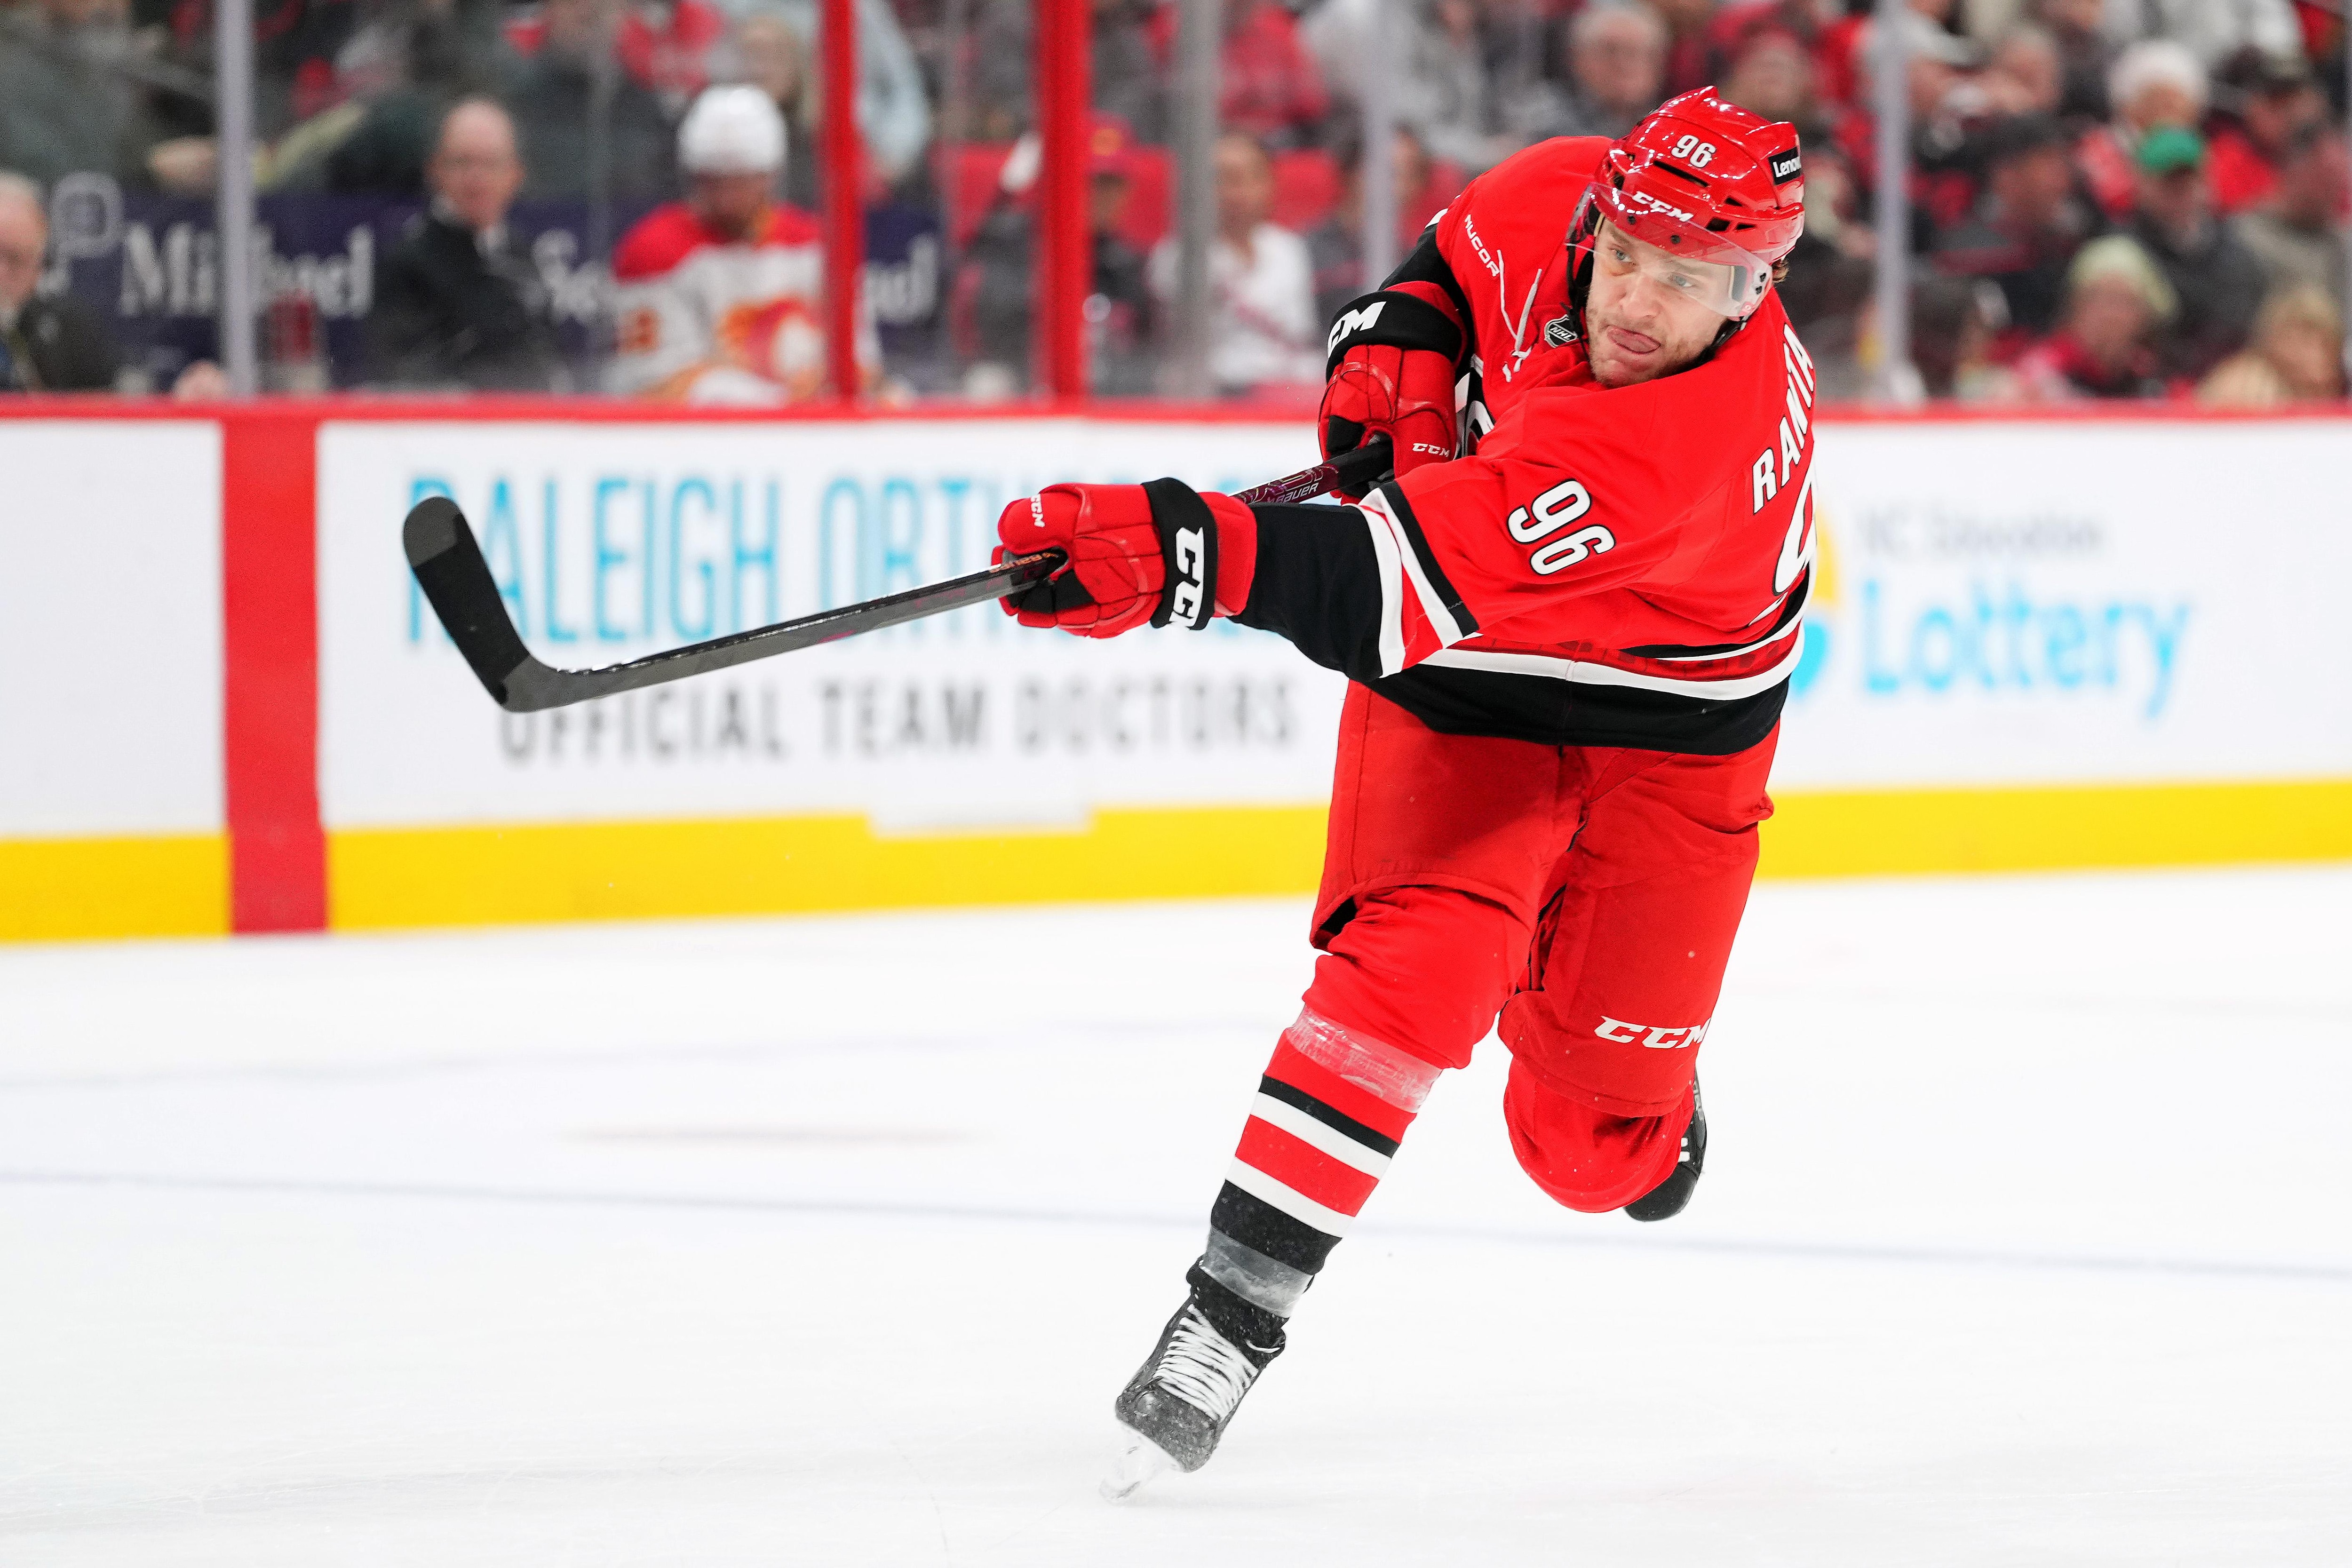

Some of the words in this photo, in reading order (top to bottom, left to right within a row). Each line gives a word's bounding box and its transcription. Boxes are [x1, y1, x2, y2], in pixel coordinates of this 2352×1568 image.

[1670, 134, 1716, 168] 96
[1632, 191, 1694, 222] CCM
[1464, 214, 1500, 277] NUCOR
[1327, 301, 1387, 358] CM
[1549, 326, 1572, 340] NHL
[1412, 443, 1450, 458] CCM
[1507, 477, 1616, 576] 96
[1860, 578, 2192, 721] Lottery
[500, 677, 789, 760] OFFICIAL
[820, 676, 985, 755] TEAM
[1015, 674, 1297, 753] DOCTORS
[1594, 1015, 1712, 1049] CCM
